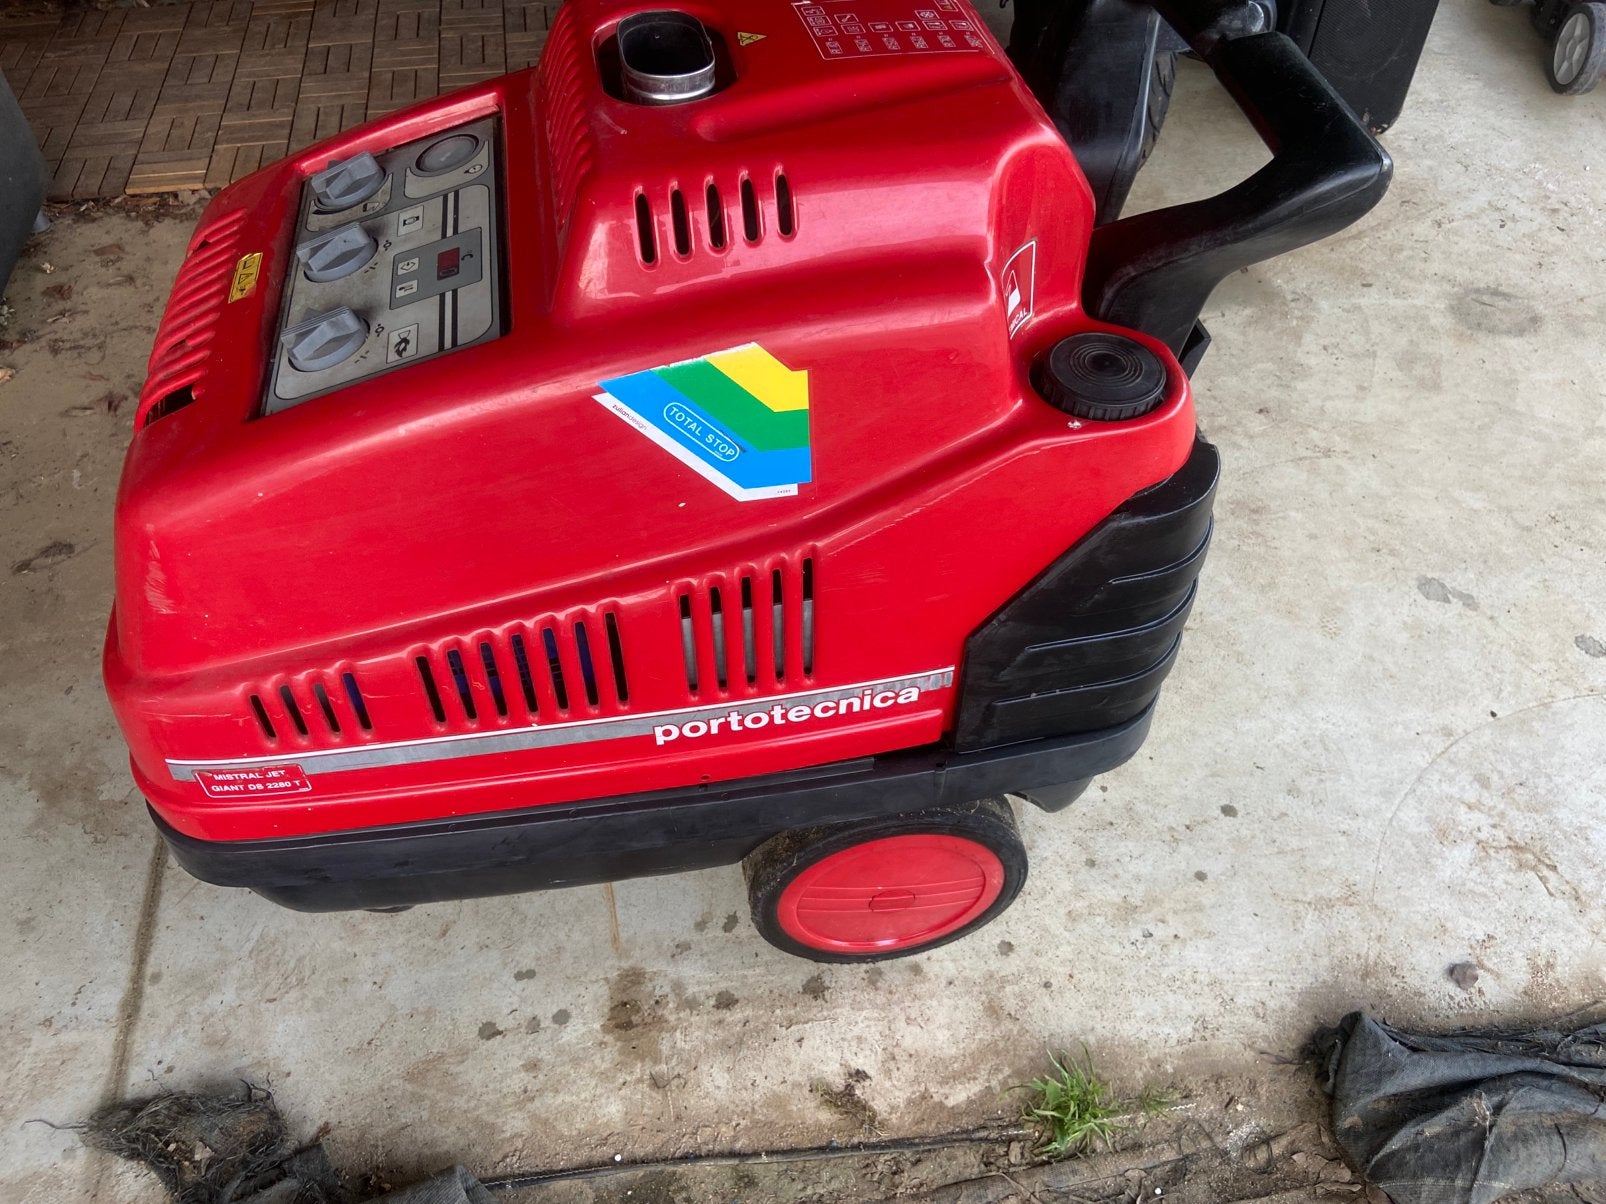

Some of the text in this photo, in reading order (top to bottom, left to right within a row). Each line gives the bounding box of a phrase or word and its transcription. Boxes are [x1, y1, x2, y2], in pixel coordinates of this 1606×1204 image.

[611, 404, 648, 431] zuliandesign
[669, 406, 735, 456] TOTAL STOP
[654, 686, 921, 746] portotecnica
[213, 770, 286, 781] MISTRAL JET
[248, 783, 264, 791] DS
